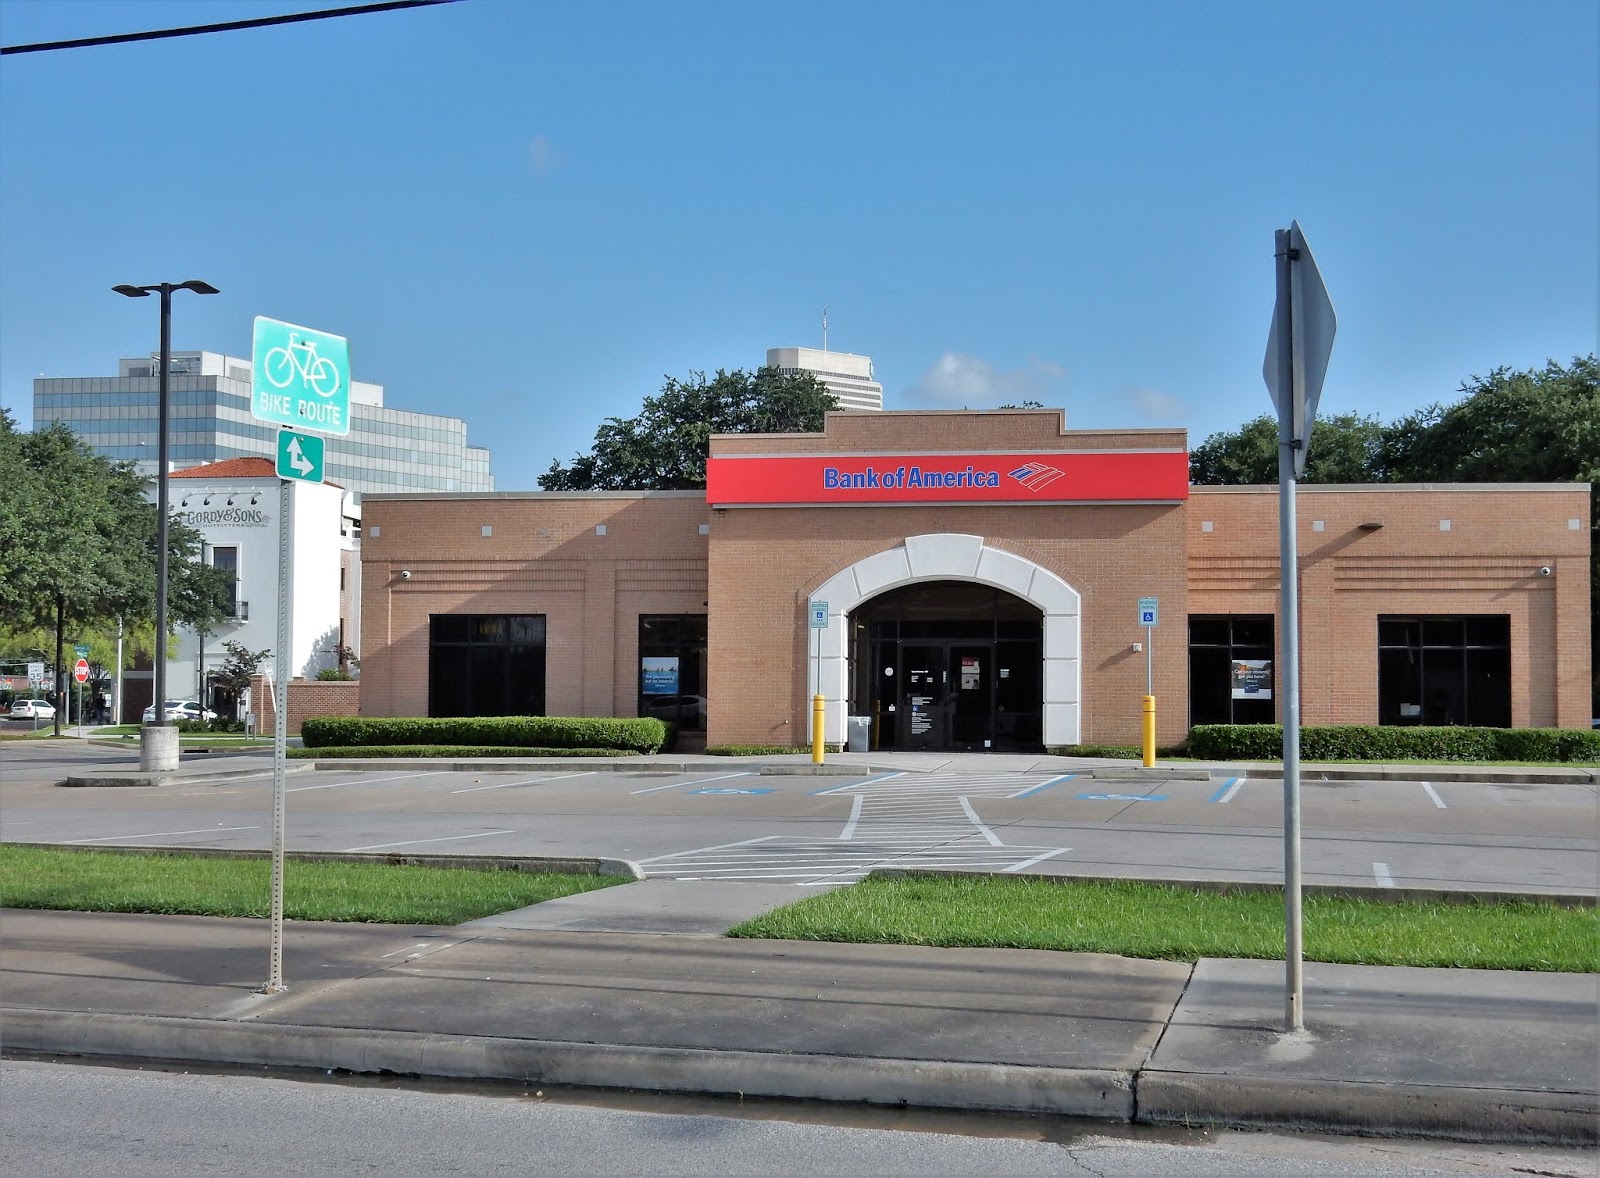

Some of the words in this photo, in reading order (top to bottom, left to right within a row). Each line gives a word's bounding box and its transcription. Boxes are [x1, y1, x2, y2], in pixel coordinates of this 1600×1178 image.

[260, 392, 291, 415] BIKE
[299, 400, 341, 425] ROUTE
[824, 467, 880, 489] Bank
[880, 467, 904, 489] of
[907, 466, 1000, 489] America
[75, 666, 90, 675] STOP
